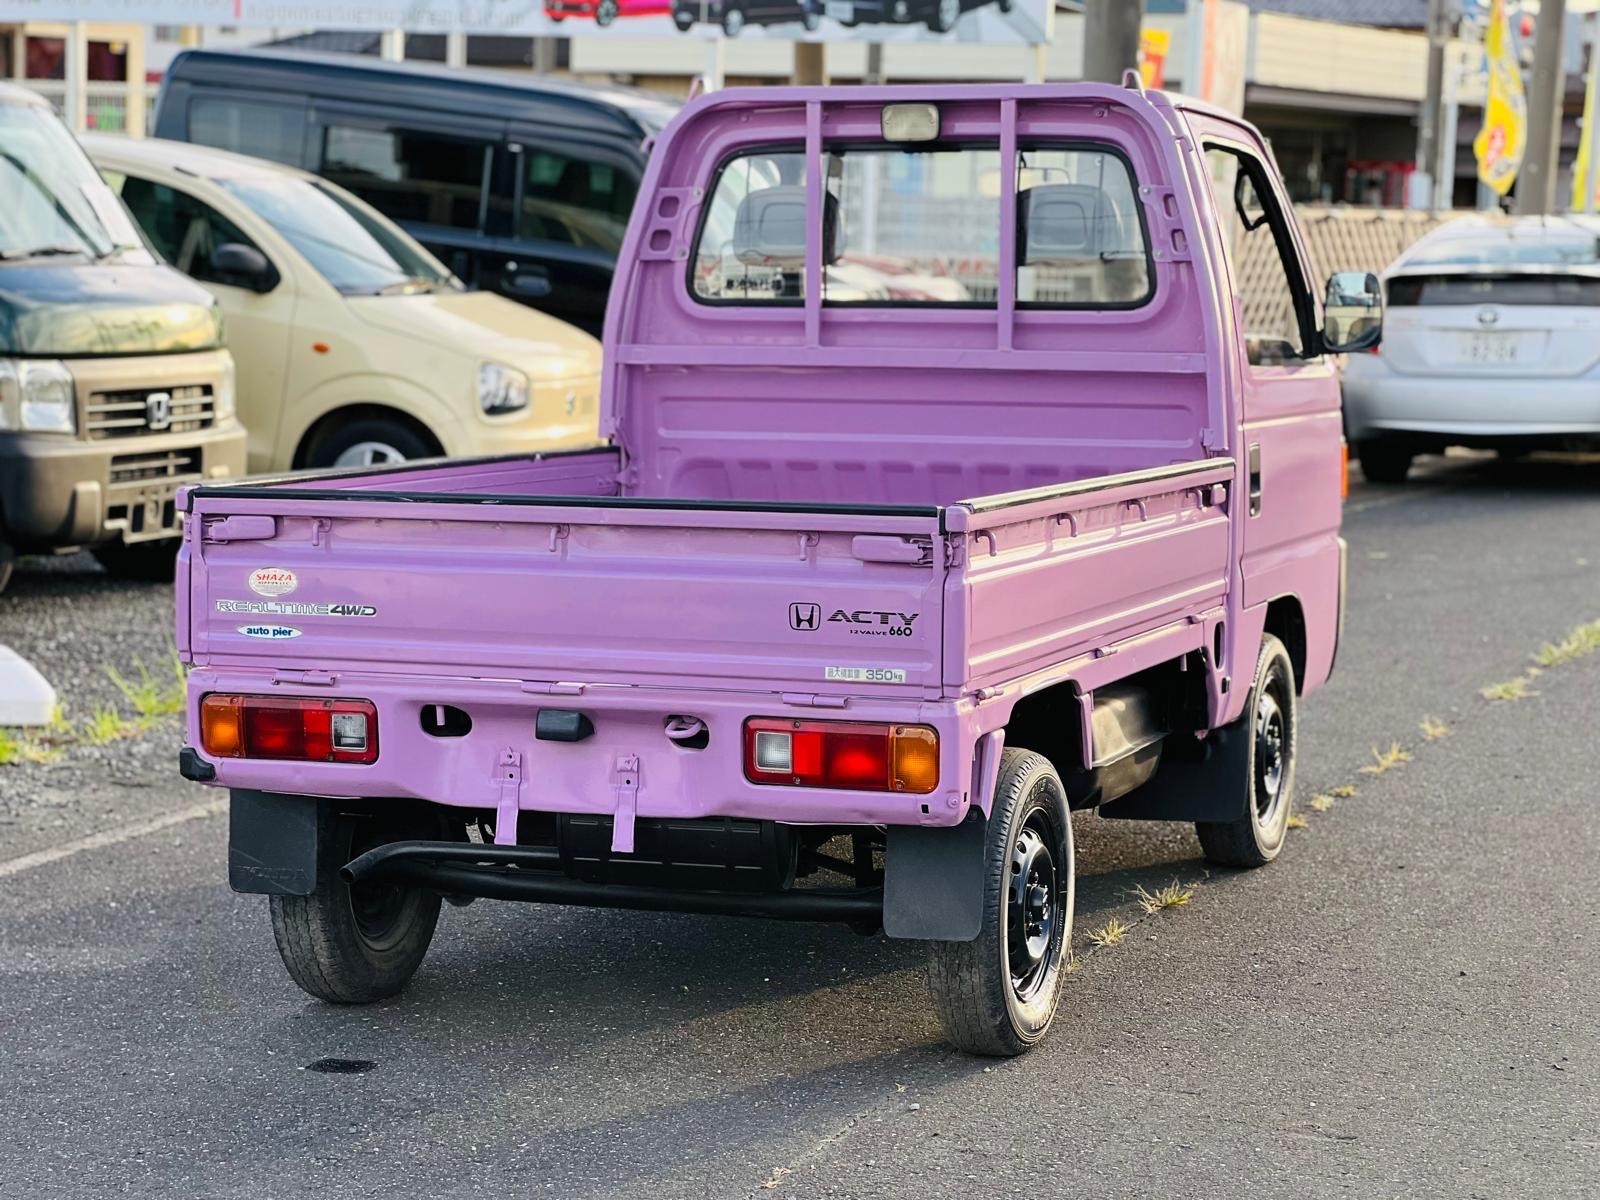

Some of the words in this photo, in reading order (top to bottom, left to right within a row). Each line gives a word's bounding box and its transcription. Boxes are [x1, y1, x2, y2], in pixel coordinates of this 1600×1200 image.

[256, 573, 292, 581] SHAZA
[827, 609, 920, 626] ACTY
[246, 626, 269, 636] auto
[272, 628, 293, 638] pier
[889, 626, 913, 637] 660
